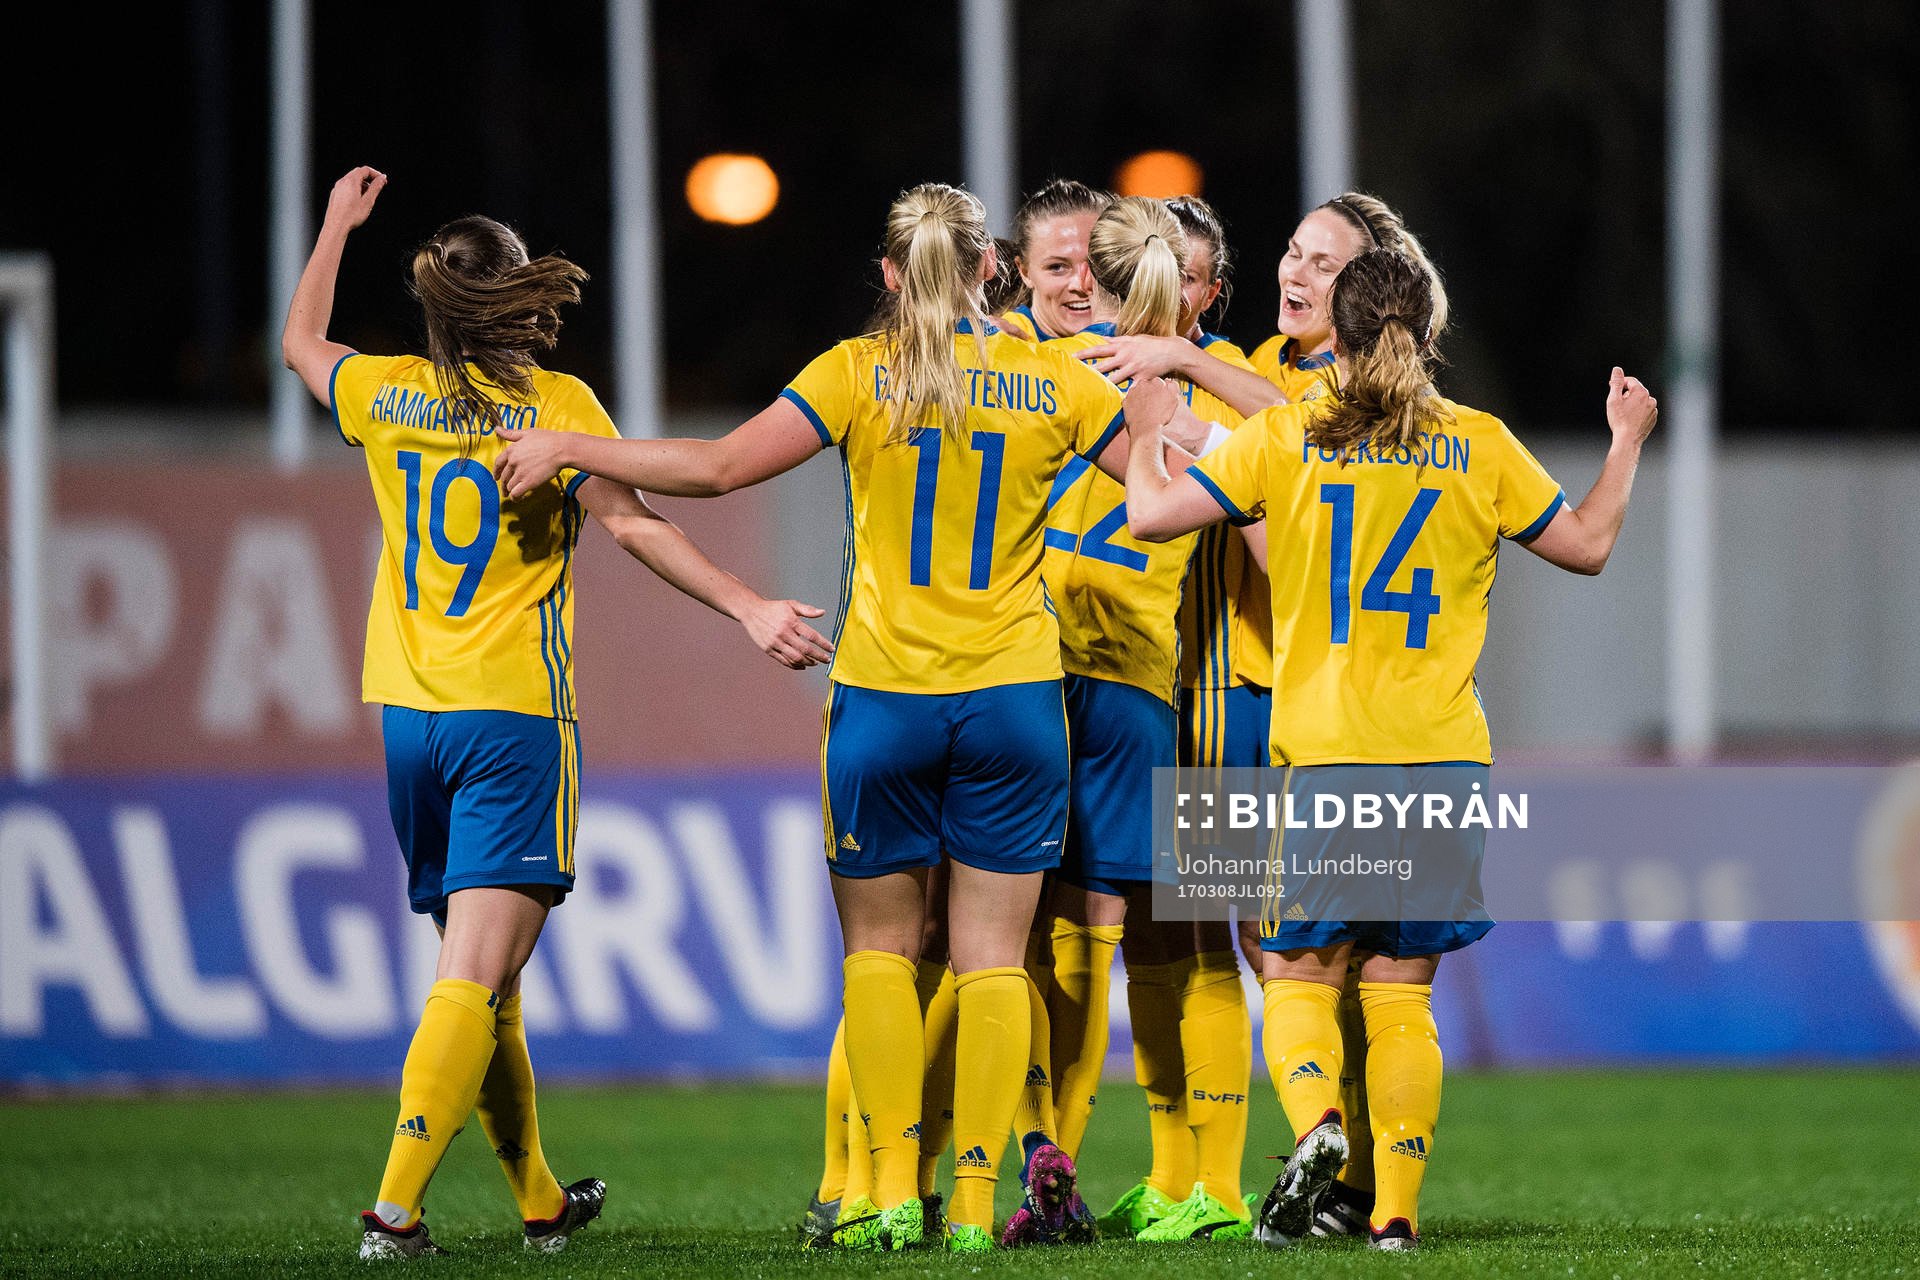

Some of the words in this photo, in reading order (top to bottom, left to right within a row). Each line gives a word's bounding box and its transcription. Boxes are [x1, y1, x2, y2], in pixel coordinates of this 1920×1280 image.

[908, 426, 1006, 590] 11
[397, 450, 501, 617] 19
[1320, 483, 1442, 650] 14
[0, 803, 824, 1036] ALGRV
[1288, 1071, 1330, 1084] adidas
[1193, 1089, 1245, 1105] SvFF
[395, 1127, 432, 1142] adidas
[1390, 1143, 1429, 1163] adidas
[956, 1159, 992, 1169] adidas
